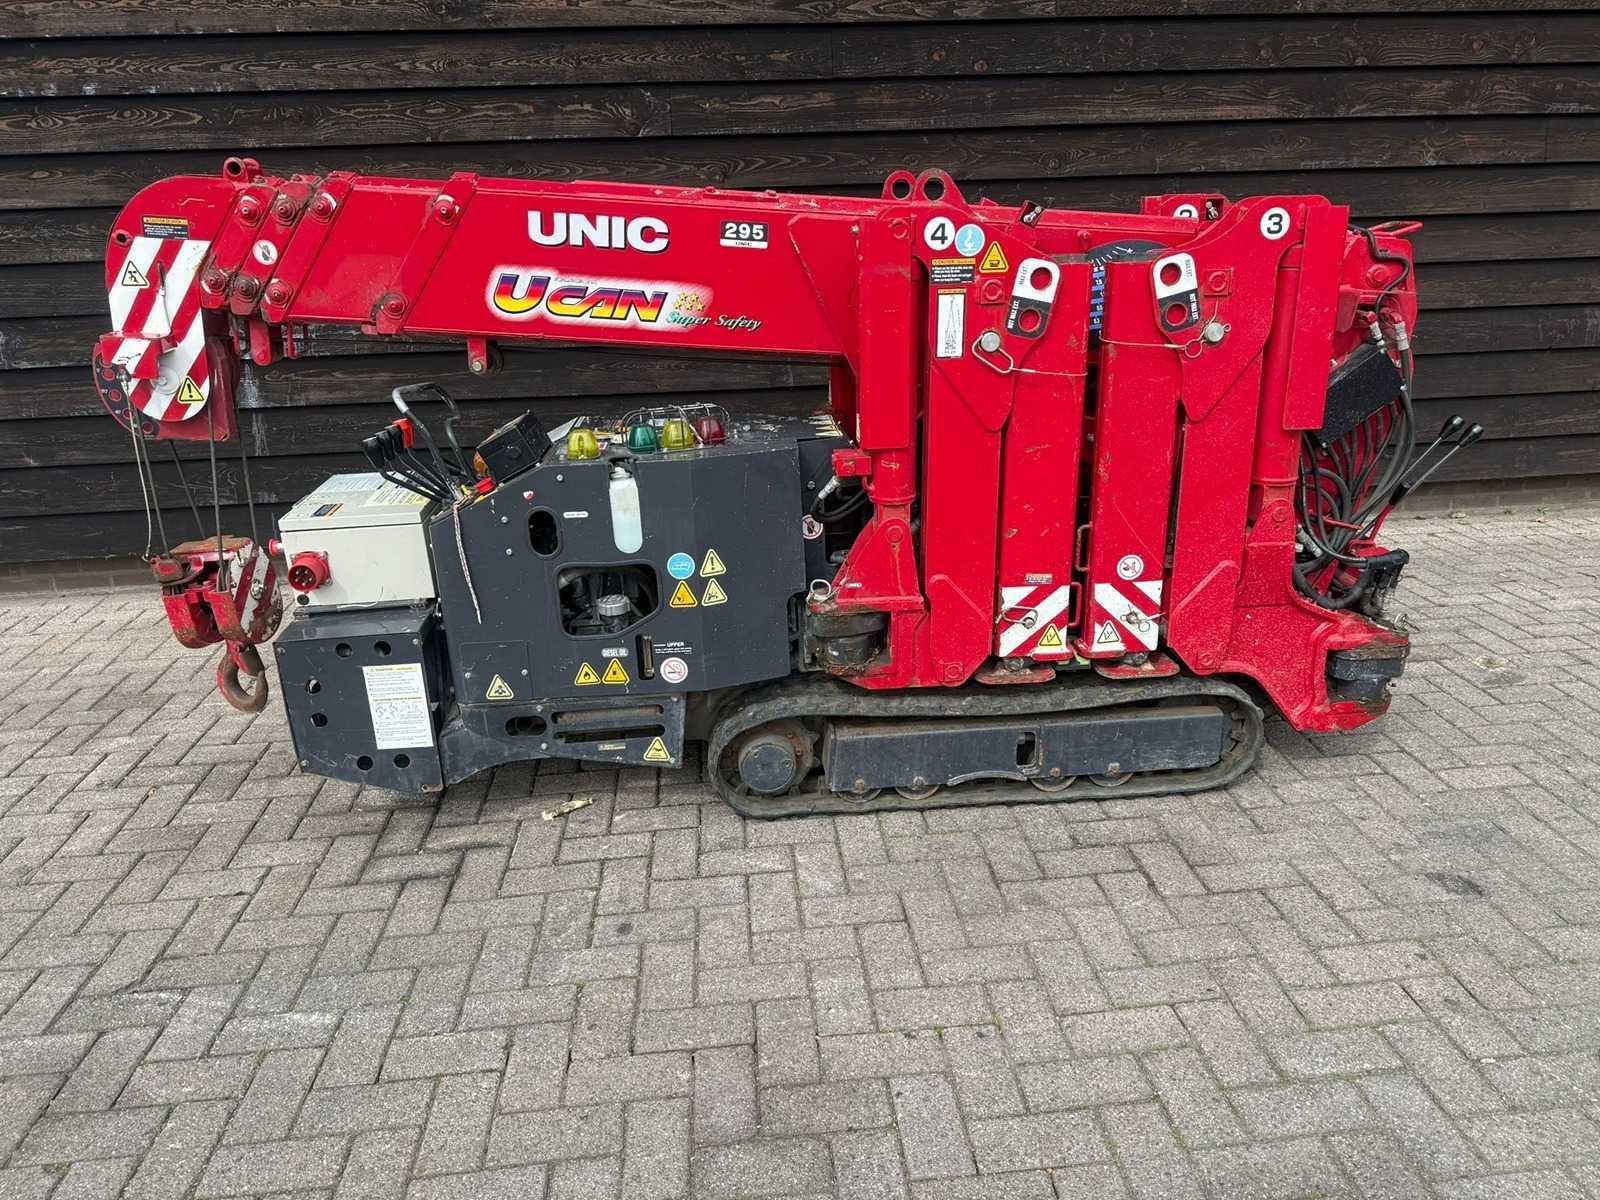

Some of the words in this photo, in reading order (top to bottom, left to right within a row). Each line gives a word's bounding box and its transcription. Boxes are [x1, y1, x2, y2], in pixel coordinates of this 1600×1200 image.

[527, 211, 669, 252] UNIC
[724, 222, 764, 240] 295
[930, 222, 948, 244] 4
[1266, 213, 1283, 234] 3
[667, 311, 712, 328] Super
[715, 314, 762, 331] Safety
